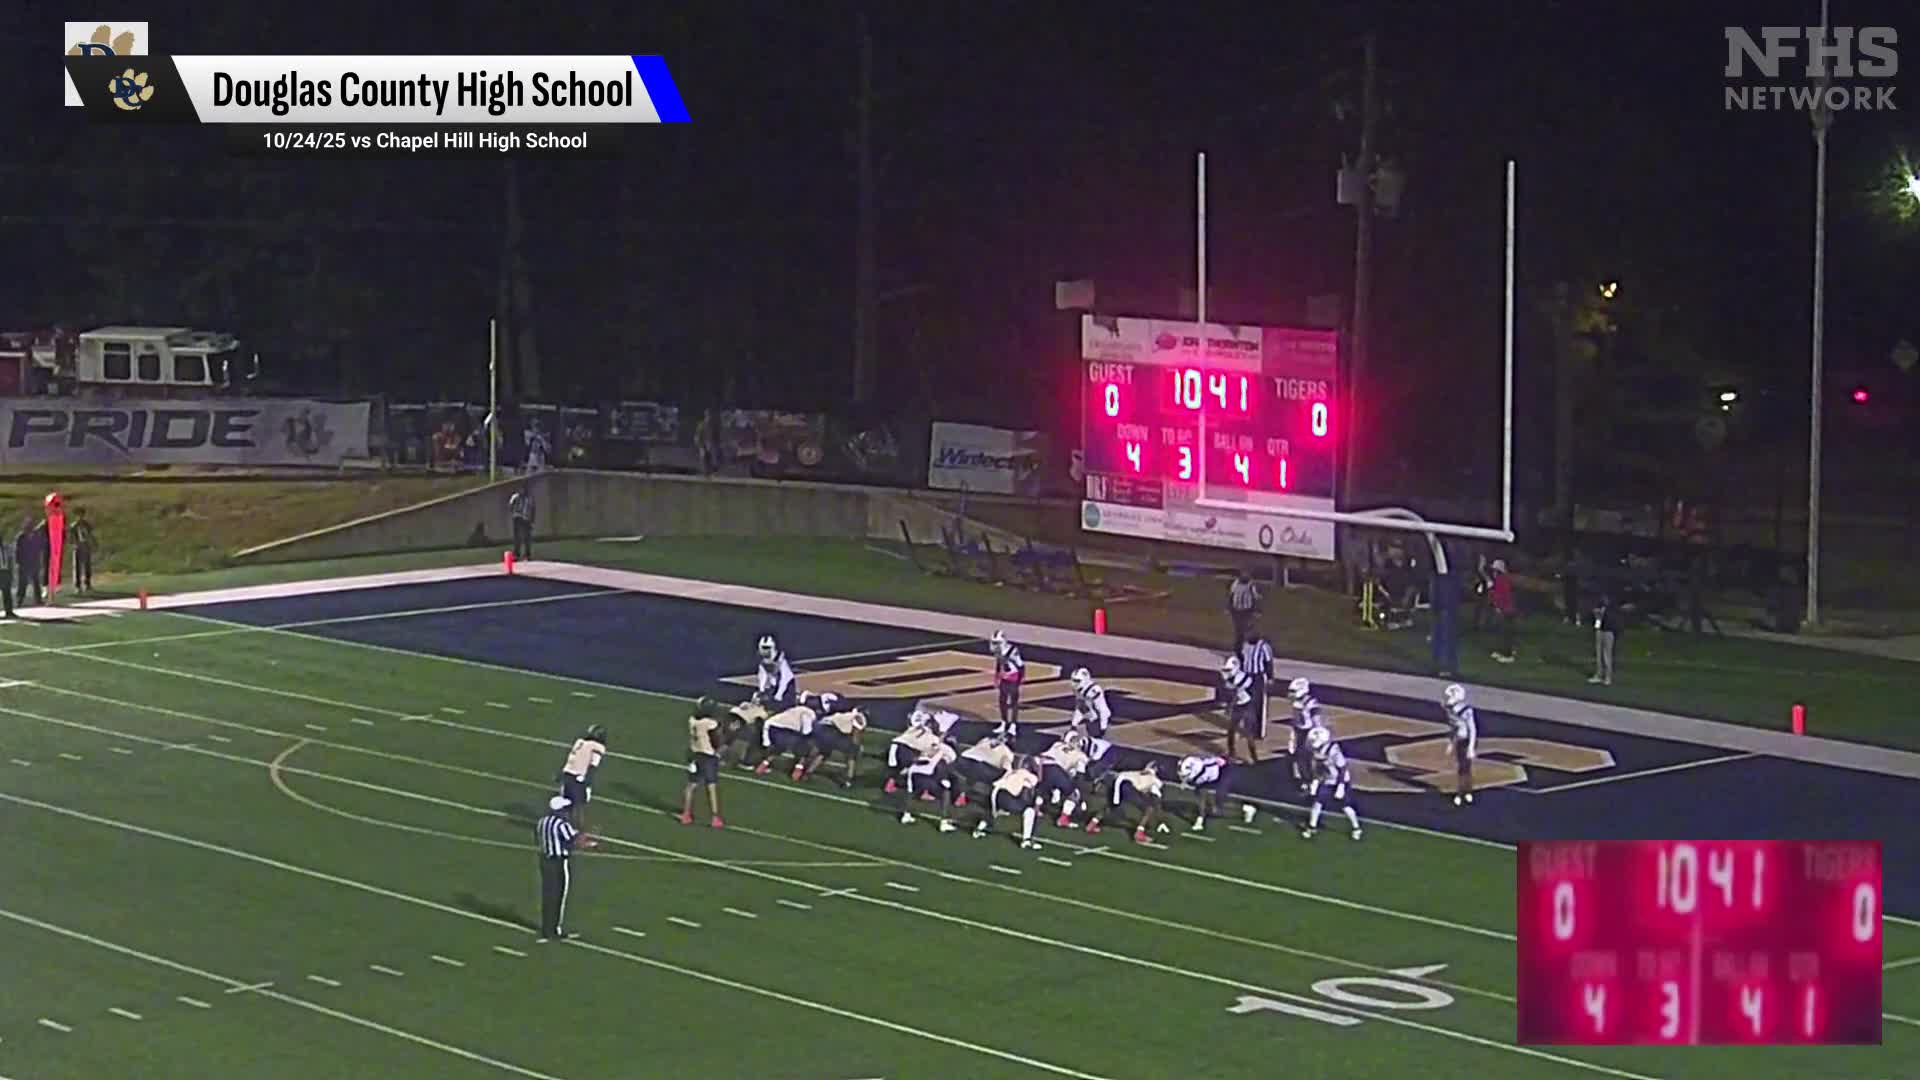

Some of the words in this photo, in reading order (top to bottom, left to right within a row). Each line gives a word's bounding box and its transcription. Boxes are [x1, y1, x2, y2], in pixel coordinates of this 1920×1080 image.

[1089, 362, 1135, 384] GUEST
[1274, 377, 1328, 401] TIGERS
[1105, 383, 1120, 417] 0
[8, 409, 260, 452] PRIDE
[1312, 402, 1328, 437] 0
[1126, 441, 1141, 473] 4
[1178, 446, 1192, 479] 3
[1267, 437, 1290, 457] QTR
[1234, 452, 1249, 484] 4
[1279, 458, 1287, 488] 1
[1225, 976, 1455, 1026] 10
